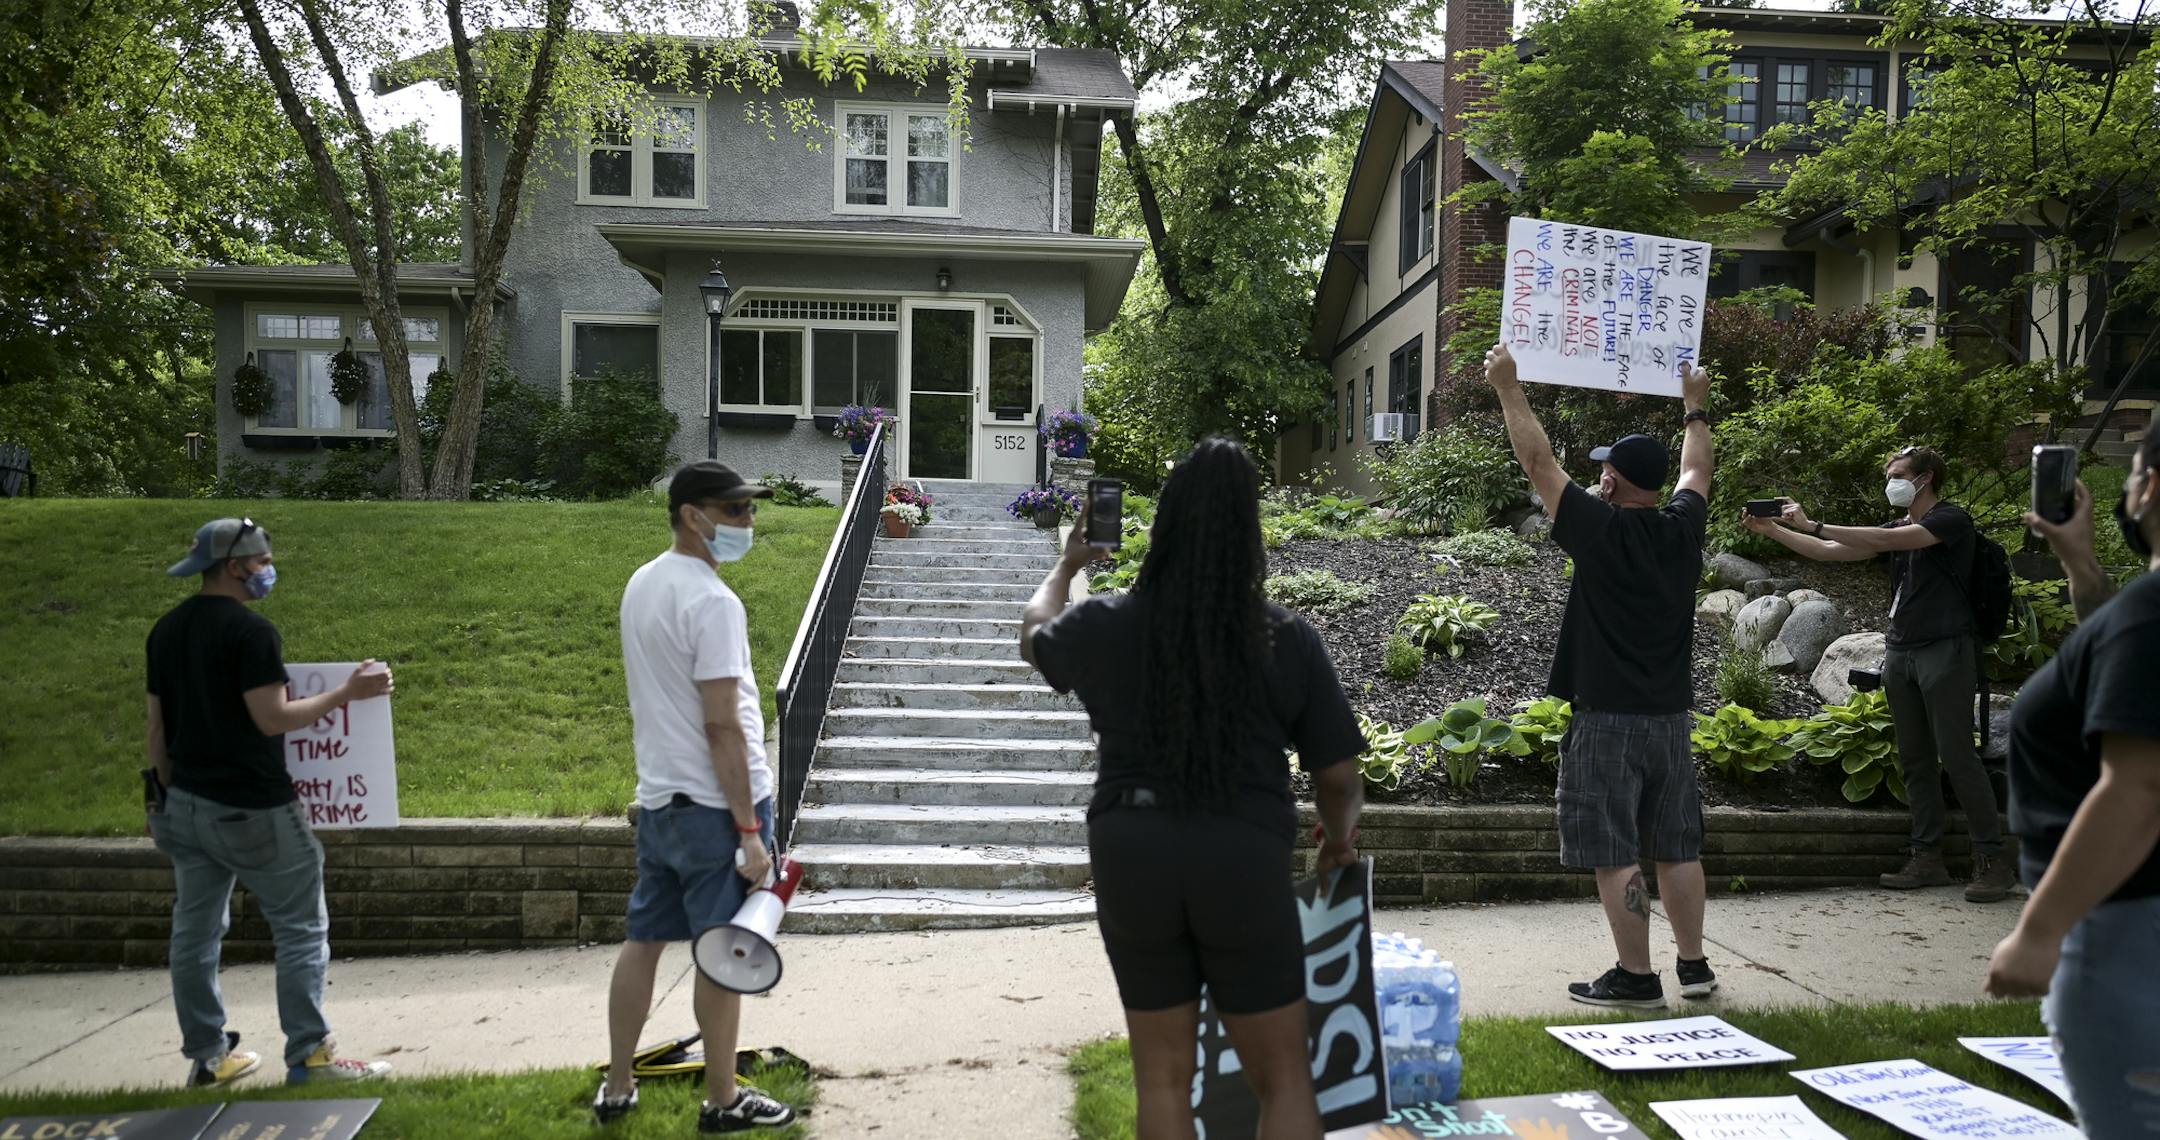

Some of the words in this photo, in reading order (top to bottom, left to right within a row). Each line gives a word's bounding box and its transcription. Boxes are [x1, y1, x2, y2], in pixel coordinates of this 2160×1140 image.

[1536, 223, 1553, 251] We
[1562, 227, 1579, 257] the
[1581, 230, 1599, 256] We
[1603, 234, 1617, 253] of
[1619, 236, 1636, 261] WE
[1537, 257, 1554, 292] ARE
[1603, 262, 1616, 292] the
[1657, 242, 1676, 280] the
[1681, 246, 1703, 279] We
[1510, 249, 1535, 345] CHANGE!
[1581, 267, 1597, 304] are
[1619, 269, 1636, 302] ARE
[1637, 267, 1655, 336] DANGER
[1538, 310, 1554, 346] the
[1562, 268, 1580, 358] CRIMINALS
[1618, 313, 1633, 342] THE
[1655, 295, 1673, 333] face
[1678, 294, 1697, 334] are
[1583, 315, 1600, 351] NOT
[1602, 300, 1617, 363] FUTURE!
[1617, 353, 1631, 388] FACE
[1652, 347, 1667, 371] of
[1675, 345, 1695, 378] NO
[994, 435, 1026, 450] 5152
[347, 774, 368, 797] IS
[1564, 1030, 1608, 1041] NO
[1621, 1028, 1736, 1045] JUSTICE
[1593, 1047, 1637, 1057] NO
[1656, 1048, 1761, 1063] PEACE
[1811, 1070, 1861, 1087] Old
[1414, 1110, 1515, 1138] Shoot
